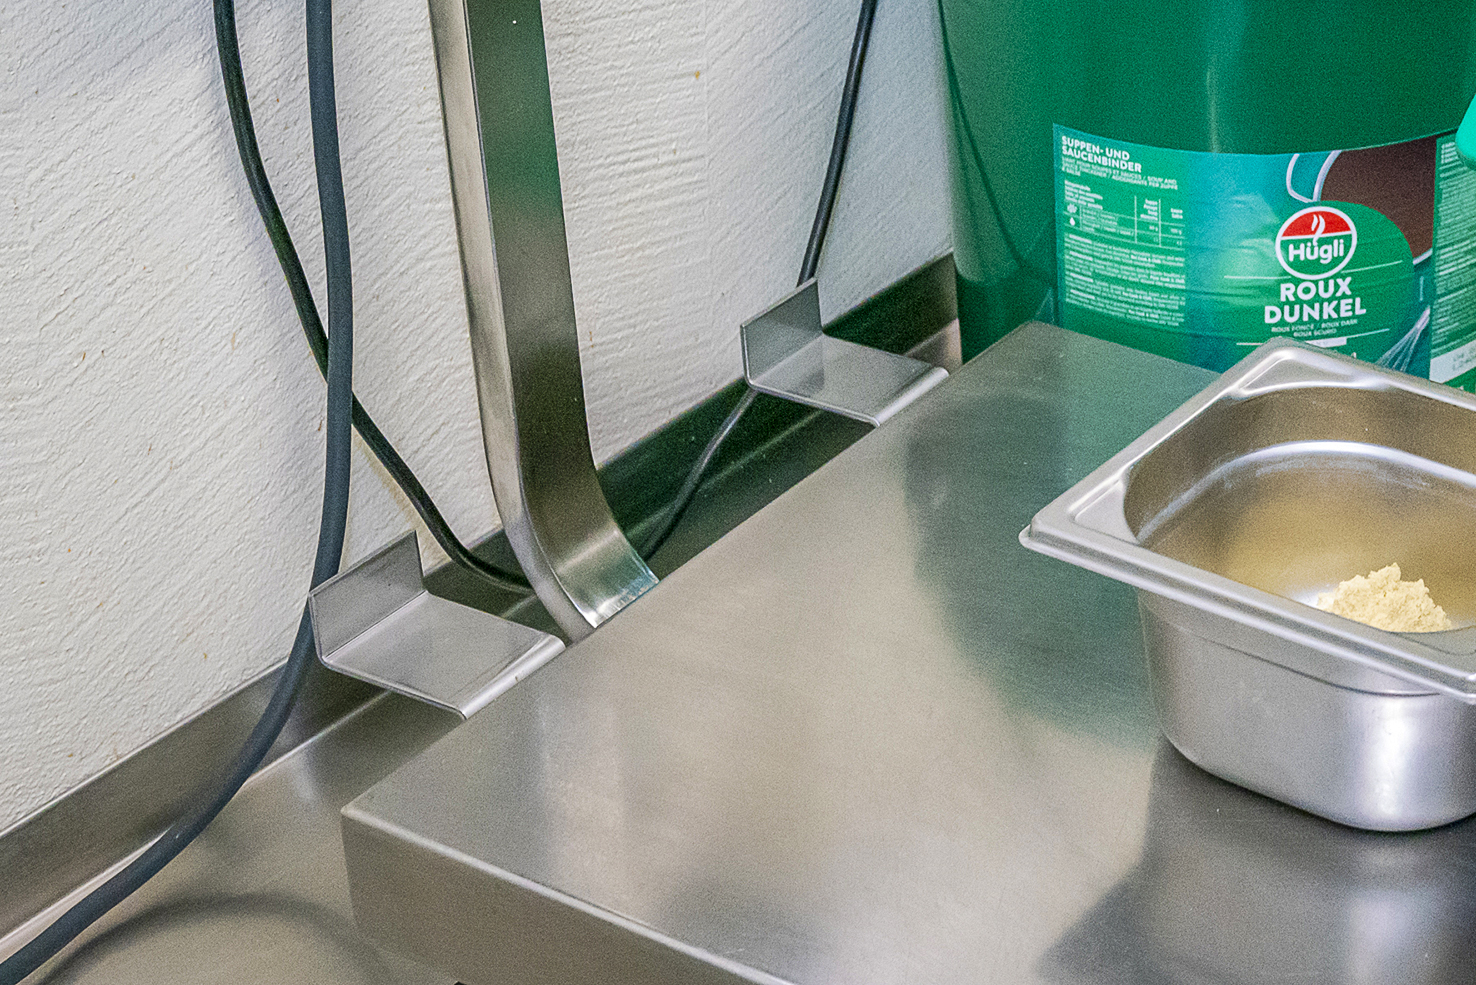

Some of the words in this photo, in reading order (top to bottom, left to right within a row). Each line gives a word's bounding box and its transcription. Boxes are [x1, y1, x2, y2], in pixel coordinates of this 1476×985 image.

[1062, 135, 1104, 154] SUPPEN-
[1105, 147, 1130, 161] UND
[1062, 146, 1142, 173] SAUCENBINDER
[1288, 239, 1344, 264] Hügli
[1280, 276, 1352, 302] ROUX
[1264, 297, 1367, 324] DUNKEL
